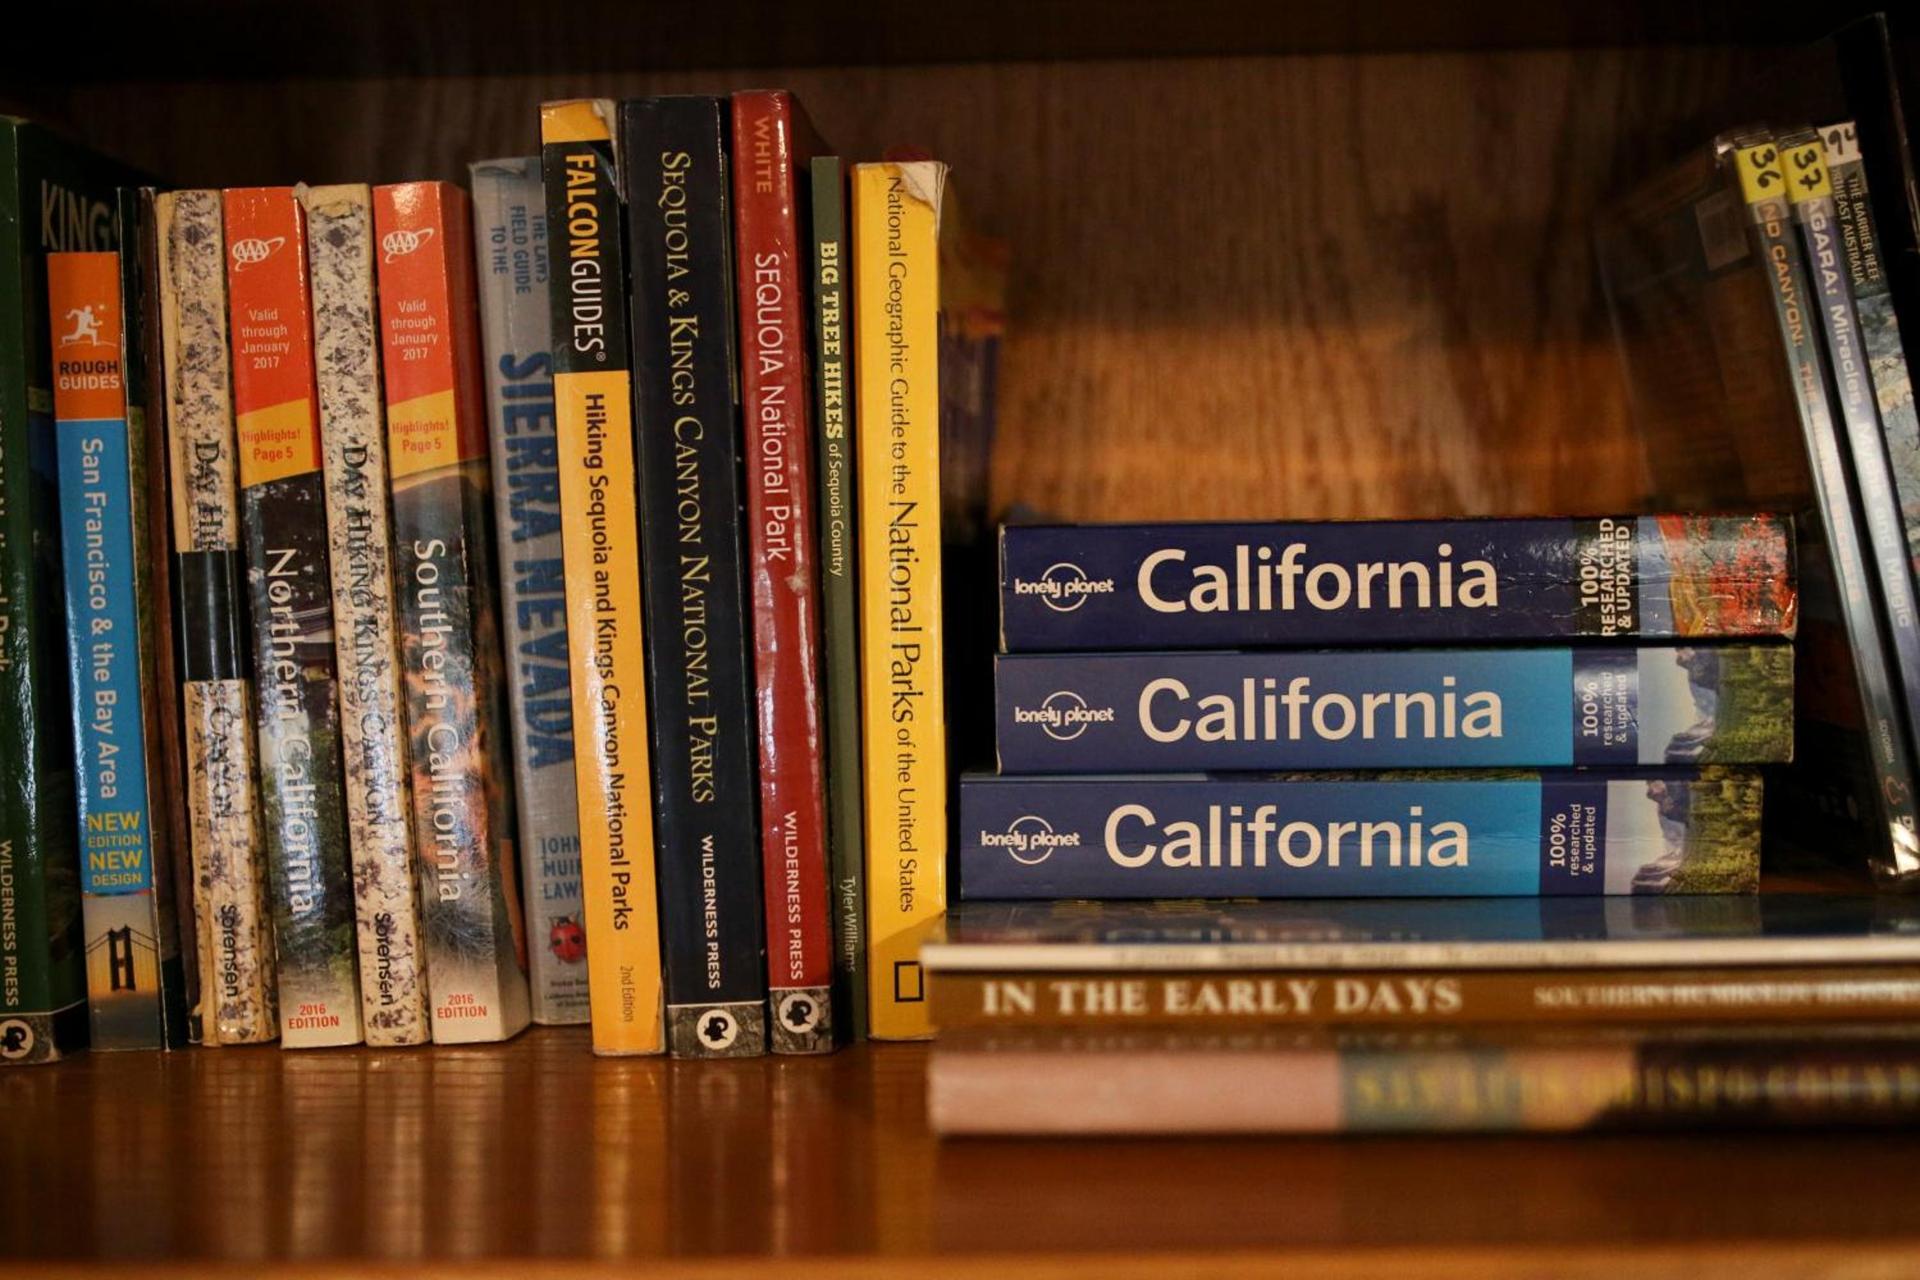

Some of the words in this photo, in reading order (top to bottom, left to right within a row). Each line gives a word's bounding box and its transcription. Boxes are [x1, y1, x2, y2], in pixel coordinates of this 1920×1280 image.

[755, 116, 773, 194] WHITE
[1751, 148, 1781, 189] 36
[1794, 149, 1822, 192] 37
[490, 226, 506, 243] TO
[510, 205, 528, 246] FIELD
[658, 151, 691, 281] SEQUOIA
[886, 177, 908, 257] National
[1852, 202, 1874, 255] BARRIER
[493, 249, 509, 275] THE
[820, 241, 839, 285] BIG
[1807, 197, 1839, 296] AGARA:
[1843, 224, 1866, 286] AUSTRALIA
[513, 252, 531, 295] GUIDE
[668, 289, 690, 308] &
[241, 323, 288, 340] through
[249, 308, 279, 322] Valid
[391, 315, 436, 330] through
[397, 299, 427, 313] Valid
[754, 253, 785, 376] SEQUOIA
[822, 291, 841, 356] TREE
[885, 261, 910, 374] Geographic
[241, 339, 290, 355] January
[253, 356, 280, 369] 2017
[392, 331, 438, 347] January
[402, 348, 429, 361] 2017
[669, 314, 699, 406] KINGS
[59, 360, 119, 376] ROUGH
[59, 375, 120, 390] GUIDES
[823, 361, 843, 440] HIKES
[890, 378, 911, 438] Guide
[241, 428, 301, 445] Highlights!
[391, 420, 449, 436] Highlights!
[402, 439, 433, 453] Page
[434, 438, 442, 450] 5
[499, 352, 561, 543] SIERRA
[584, 393, 607, 470] Hiking
[759, 385, 789, 495] National
[828, 444, 844, 461] of
[892, 442, 908, 459] to
[82, 438, 104, 484] San
[253, 448, 284, 463] Page
[286, 447, 294, 459] 5
[342, 447, 368, 500] DAY
[674, 416, 704, 545] CANYON
[892, 464, 911, 495] the
[826, 460, 844, 517] Sequoia
[586, 475, 613, 565] Sequoia
[765, 505, 792, 562] Park
[84, 492, 111, 610] Francisco
[346, 508, 373, 609] HIKING
[829, 519, 845, 577] Country
[888, 501, 922, 632] National
[1615, 526, 1632, 612] UPDATED
[592, 572, 617, 612] and
[1014, 577, 1062, 599] lonely
[1064, 577, 1114, 598] planet
[1137, 543, 1499, 613] California
[1580, 548, 1599, 607] 100%
[1599, 518, 1617, 637] RESEARCHED
[91, 618, 112, 635] &
[265, 548, 306, 721] Northern
[414, 539, 453, 711] Southern
[680, 555, 710, 706] NATIONAL
[1616, 615, 1632, 629] &
[92, 643, 116, 683] the
[353, 618, 380, 703] KINGS
[513, 556, 575, 769] NEVADA
[594, 618, 618, 680] Kings
[891, 643, 923, 723] Parks
[1138, 675, 1504, 743] California
[1582, 681, 1599, 737] 100%
[92, 690, 117, 735] Bay
[896, 728, 916, 747] of
[1014, 705, 1062, 727] lonely
[1064, 705, 1115, 727] planet
[1615, 732, 1628, 743] &
[98, 742, 120, 799] Area
[688, 716, 717, 804] PARKS
[897, 752, 917, 783] the
[87, 811, 141, 833] NEW
[278, 736, 326, 914] California
[426, 723, 470, 902] California
[607, 773, 632, 866] National
[897, 788, 918, 852] United
[1104, 803, 1469, 867] California
[1583, 806, 1597, 860] updated
[87, 835, 142, 847] EDITION
[88, 849, 143, 871] NEW
[980, 829, 1028, 851] lonely
[1029, 829, 1080, 850] planet
[1549, 813, 1567, 867] 100%
[1569, 803, 1582, 876] researched
[92, 873, 142, 887] DESIGN
[700, 835, 717, 938] WILDERNESS
[783, 811, 801, 924] WILDERNESS
[839, 875, 857, 911] Tyler
[900, 859, 918, 913] States
[1582, 863, 1594, 874] &
[0, 839, 17, 952] WILDERNESS
[611, 872, 635, 931] Parks
[219, 904, 240, 998] Sorensen
[373, 912, 395, 1006] Sorensen
[619, 965, 635, 986] 2nd
[706, 941, 721, 990] PRESS
[789, 928, 804, 980] PRESS
[4, 956, 19, 1007] PRESS
[447, 993, 474, 1006] 2016
[620, 988, 635, 1023] Edition
[981, 979, 1037, 1016] IN
[1049, 979, 1147, 1016] THE
[1163, 979, 1320, 1015] EARLY
[1332, 977, 1464, 1014] DAYS
[288, 1015, 340, 1030] EDITION
[299, 1003, 327, 1016] 2016
[436, 1005, 487, 1019] EDITION
